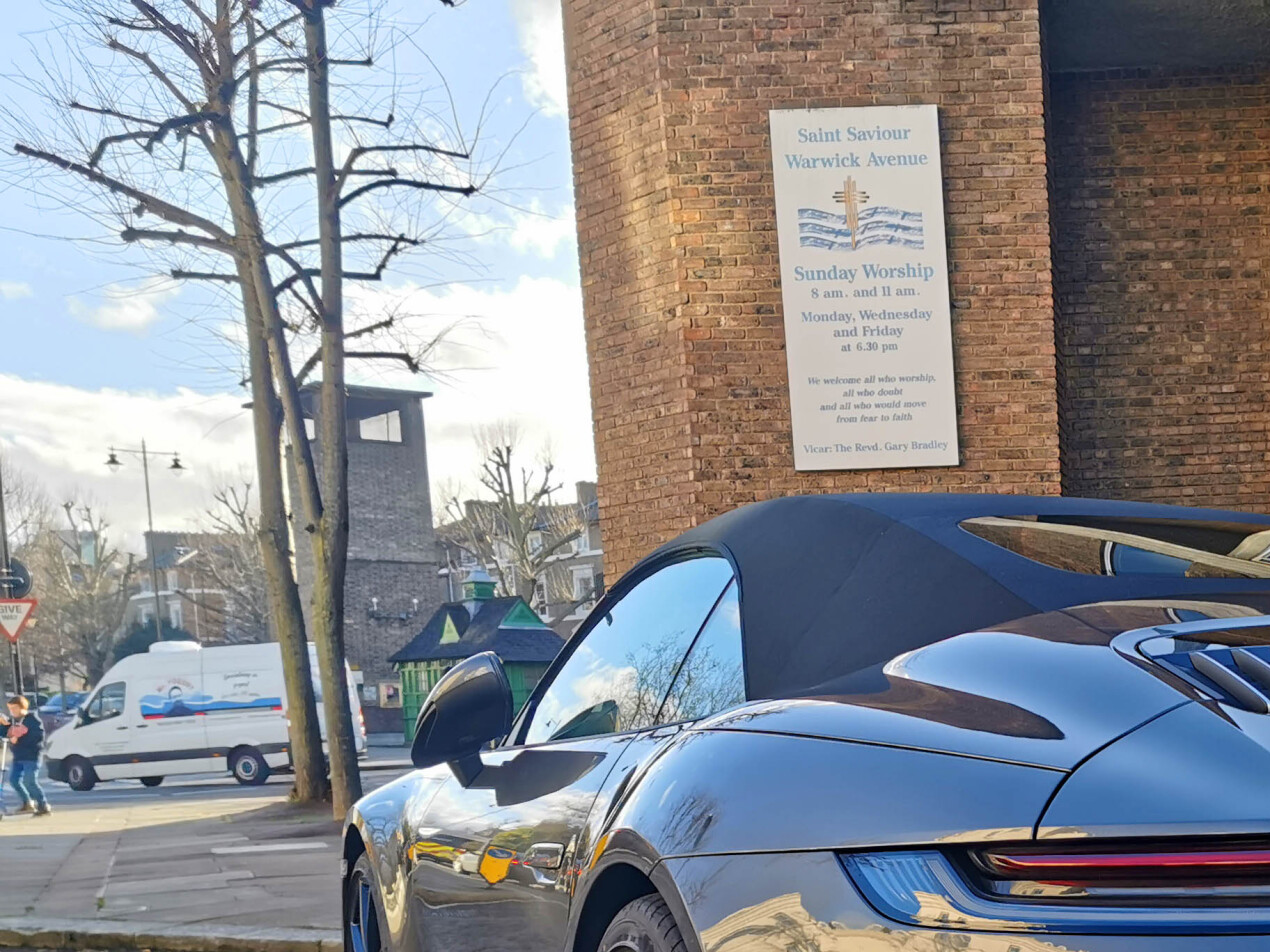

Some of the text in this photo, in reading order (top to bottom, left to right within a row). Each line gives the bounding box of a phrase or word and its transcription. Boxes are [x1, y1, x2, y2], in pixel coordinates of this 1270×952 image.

[797, 125, 911, 143] Saint Saviour
[785, 152, 929, 169] Warwick Avenue
[794, 263, 935, 283] Sunday Worship
[811, 286, 921, 299] 8 am. and 11 am.
[801, 308, 933, 324] Monday, Wednesday
[833, 325, 904, 338] and Friday
[841, 341, 898, 353] at 6.30 pm
[808, 377, 820, 385] We
[823, 376, 861, 385] welcome
[864, 375, 876, 384] all
[878, 375, 896, 383] who
[842, 388, 903, 397] all who doubt
[820, 402, 837, 411] and
[839, 402, 851, 410] all
[853, 401, 872, 409] who
[874, 400, 901, 408] would
[836, 414, 858, 423] from
[860, 414, 878, 422] fear
[892, 412, 913, 421] faith
[803, 444, 832, 453] Vicar:
[833, 443, 852, 452] The
[884, 441, 908, 452] Gary
[911, 440, 948, 451] Bradley
